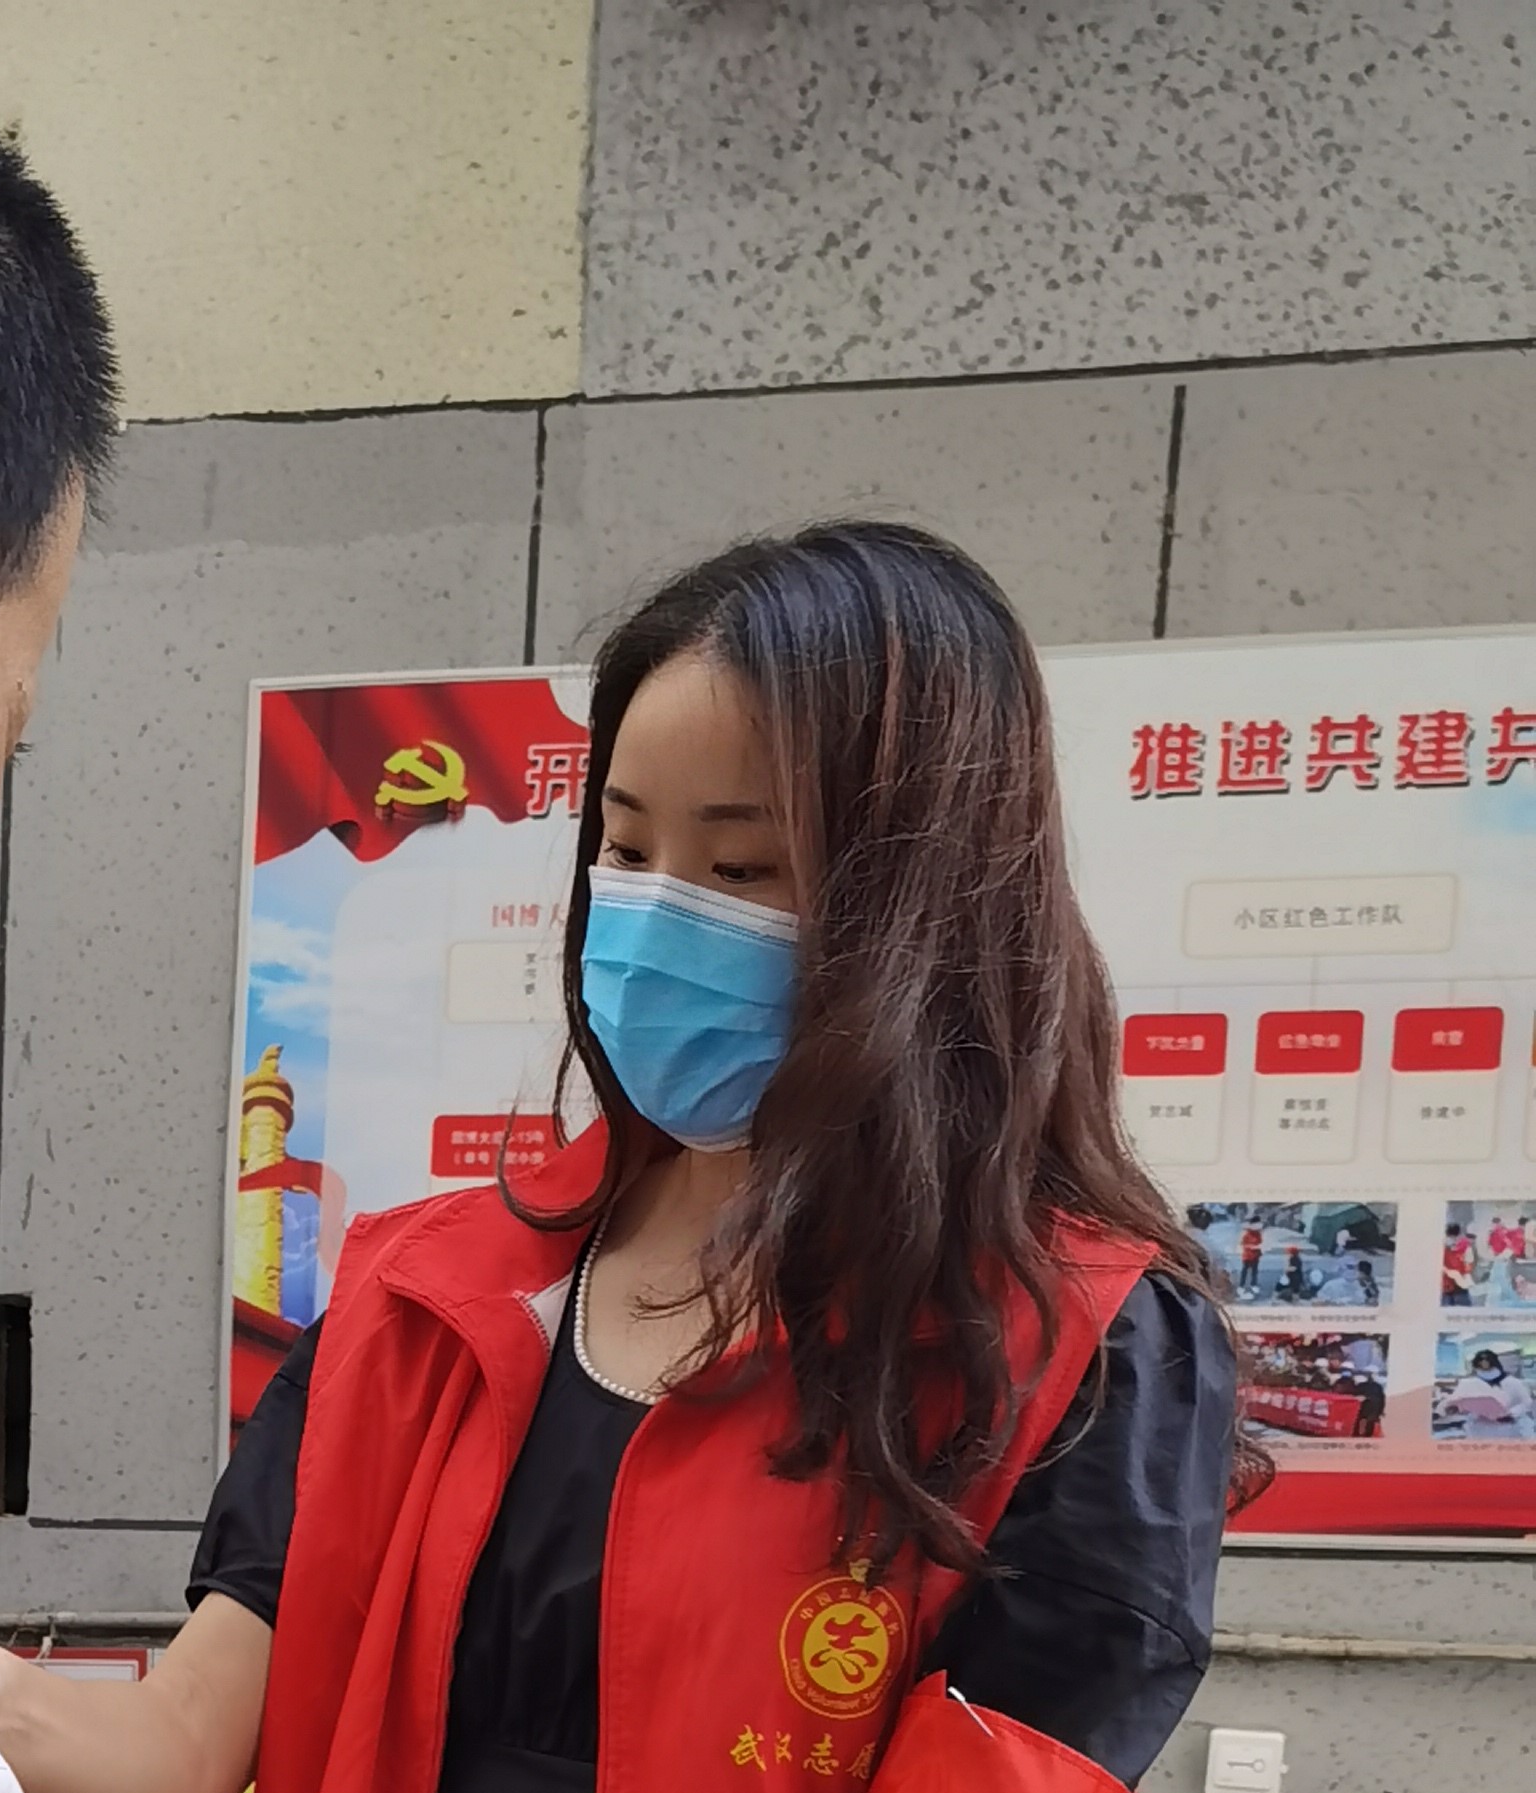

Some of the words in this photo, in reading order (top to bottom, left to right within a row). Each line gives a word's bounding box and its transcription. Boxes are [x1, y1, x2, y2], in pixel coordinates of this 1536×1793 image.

[1234, 903, 1403, 931] 小区红色工作队
